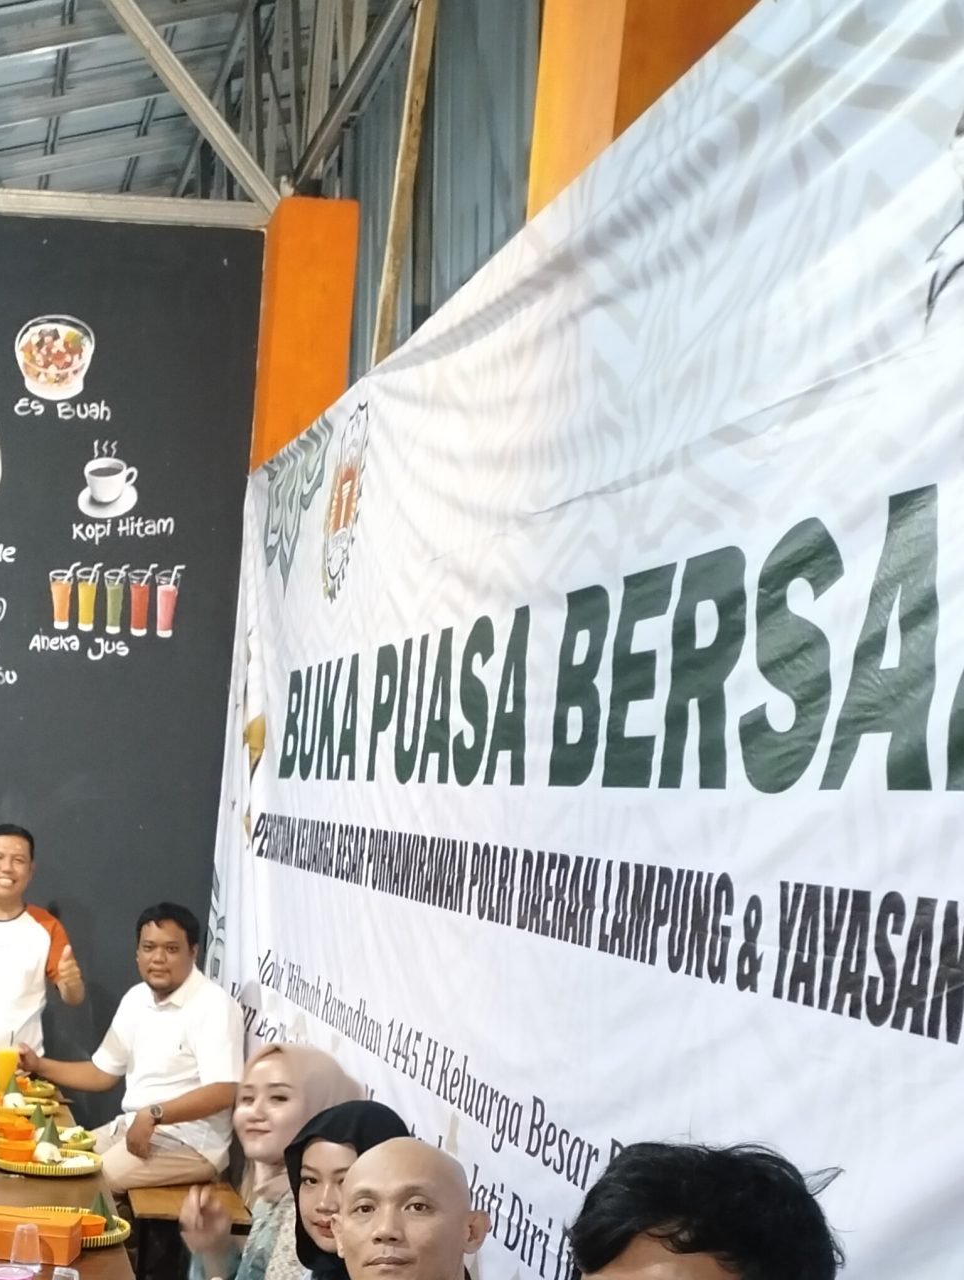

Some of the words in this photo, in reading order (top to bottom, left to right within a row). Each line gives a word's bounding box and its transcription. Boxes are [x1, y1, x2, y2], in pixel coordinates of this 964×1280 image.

[57, 399, 111, 421] Buah
[278, 653, 359, 782] BUKA
[366, 604, 530, 787] PUASA
[548, 482, 964, 795] BERSA
[334, 823, 367, 886] BESAR
[365, 828, 468, 914] PURNAWIRAWAN
[466, 841, 518, 927] POLRI
[516, 848, 601, 949] DAERAH
[598, 859, 734, 985] LAMPUNG
[736, 894, 764, 993] &
[772, 880, 964, 1045] YAYASAN
[285, 962, 321, 1018] Hikmah
[321, 982, 383, 1057] Ramadhan
[383, 1018, 423, 1080] 1445
[421, 1037, 439, 1091] H
[436, 1046, 523, 1153] Keluarga
[525, 1096, 599, 1191] Besar
[504, 1192, 553, 1278] Diri
